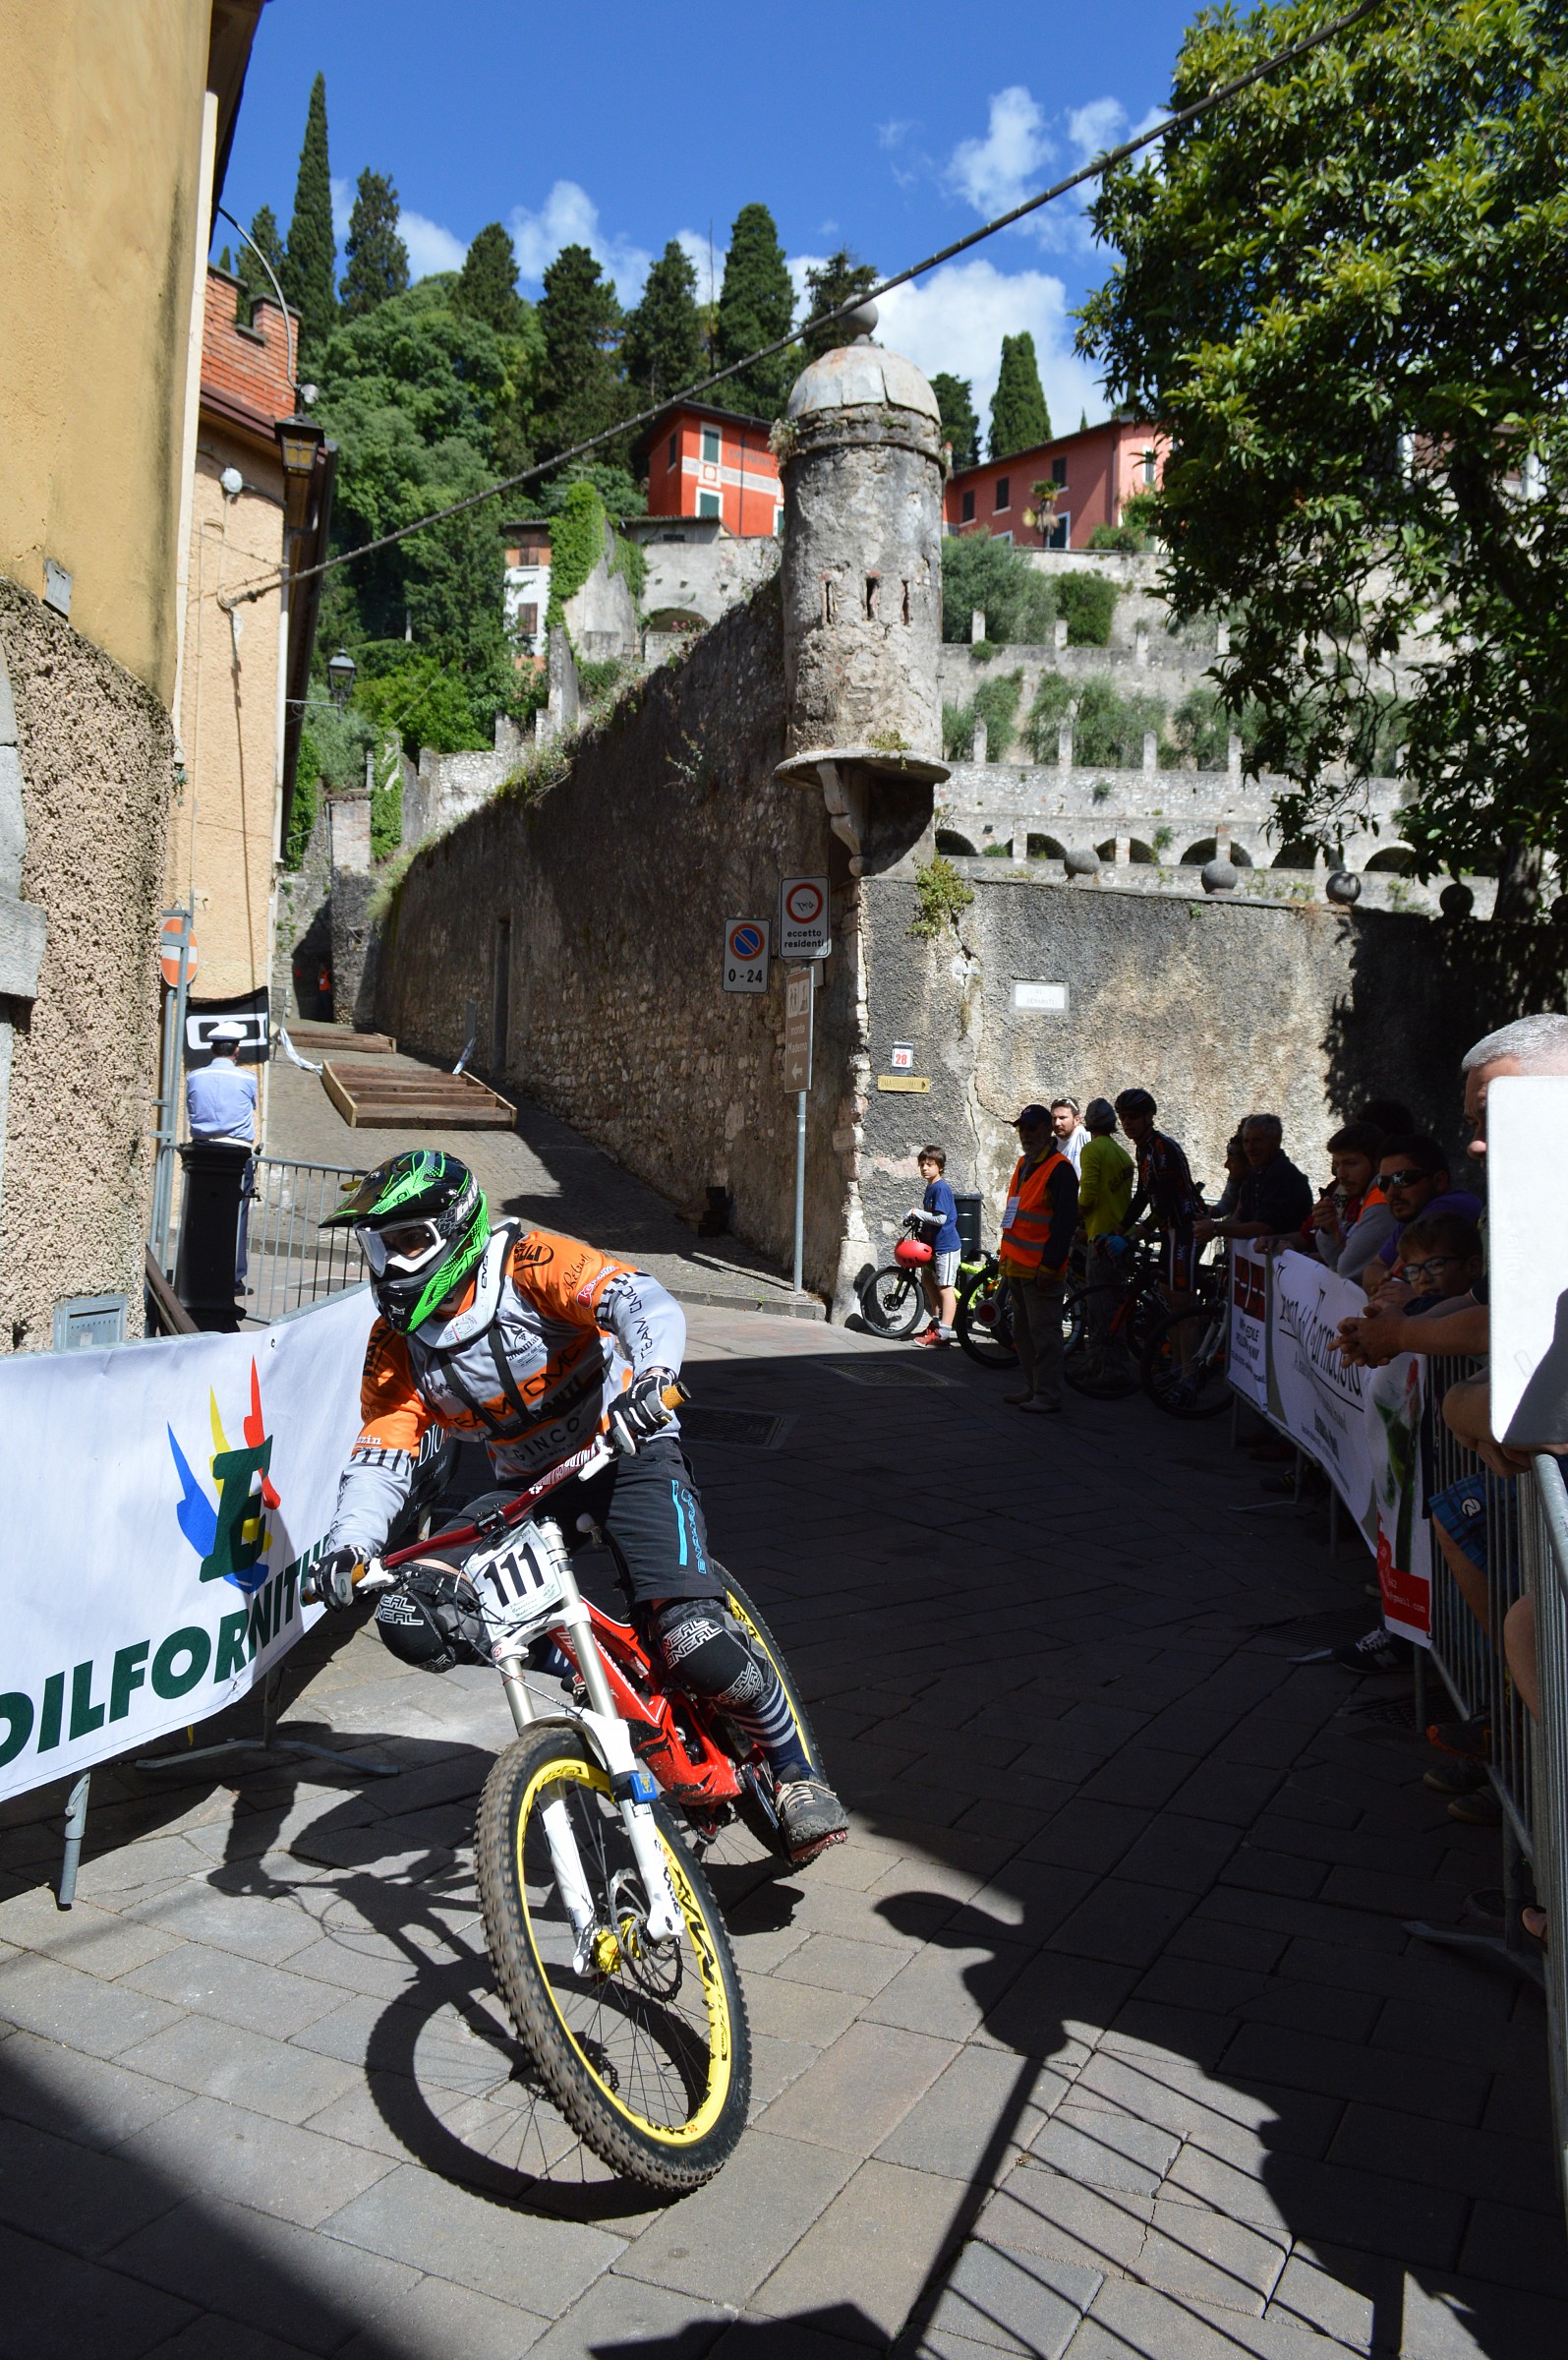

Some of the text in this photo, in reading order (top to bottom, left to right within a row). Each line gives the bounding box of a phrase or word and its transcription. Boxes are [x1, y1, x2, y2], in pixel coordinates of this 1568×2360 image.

[786, 928, 822, 938] eccetto
[784, 937, 824, 949] residenti
[895, 1053, 907, 1066] 28
[483, 1542, 545, 1609] 111
